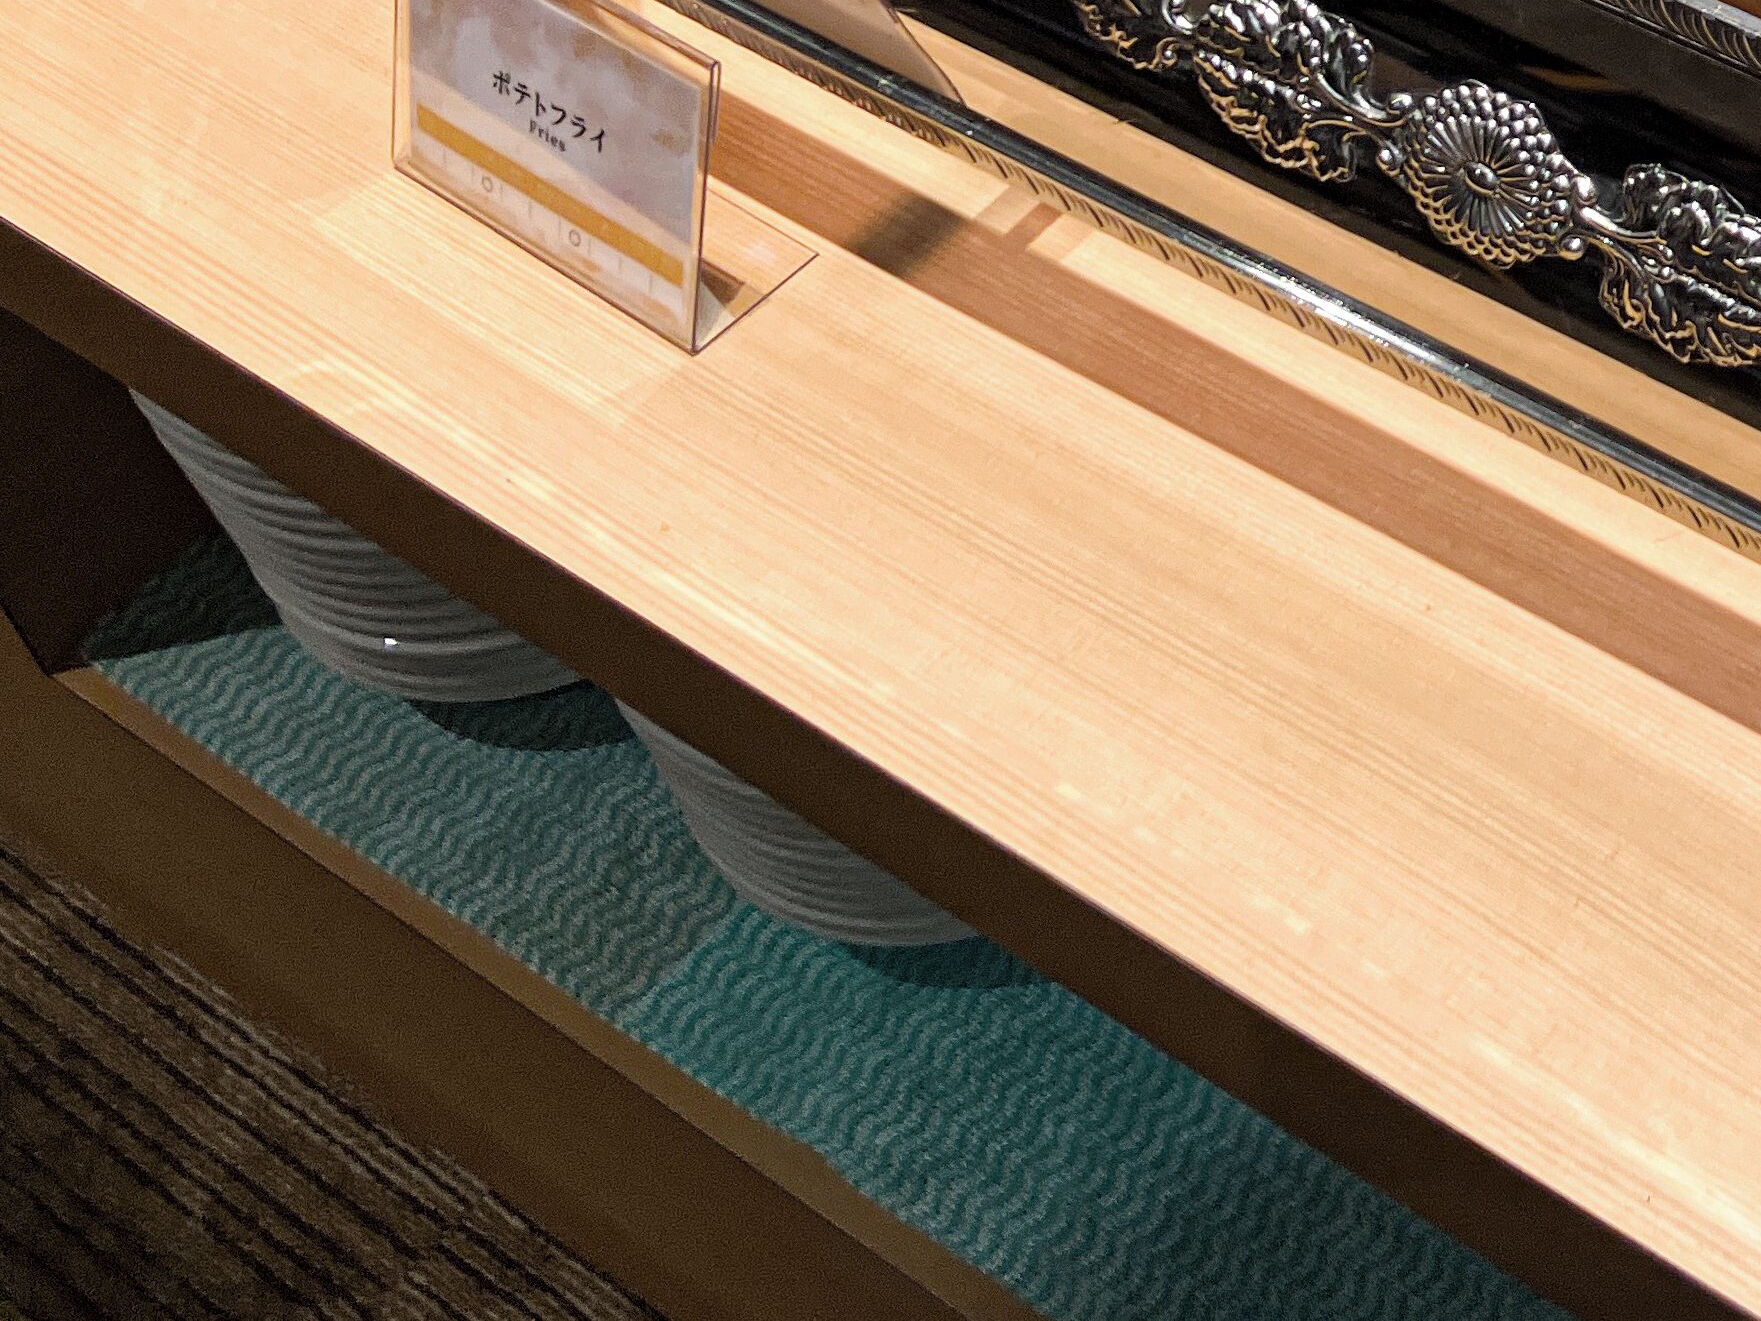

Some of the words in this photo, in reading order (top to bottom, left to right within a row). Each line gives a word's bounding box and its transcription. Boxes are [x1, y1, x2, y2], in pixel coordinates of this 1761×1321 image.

[492, 70, 605, 154] ポテトフライ
